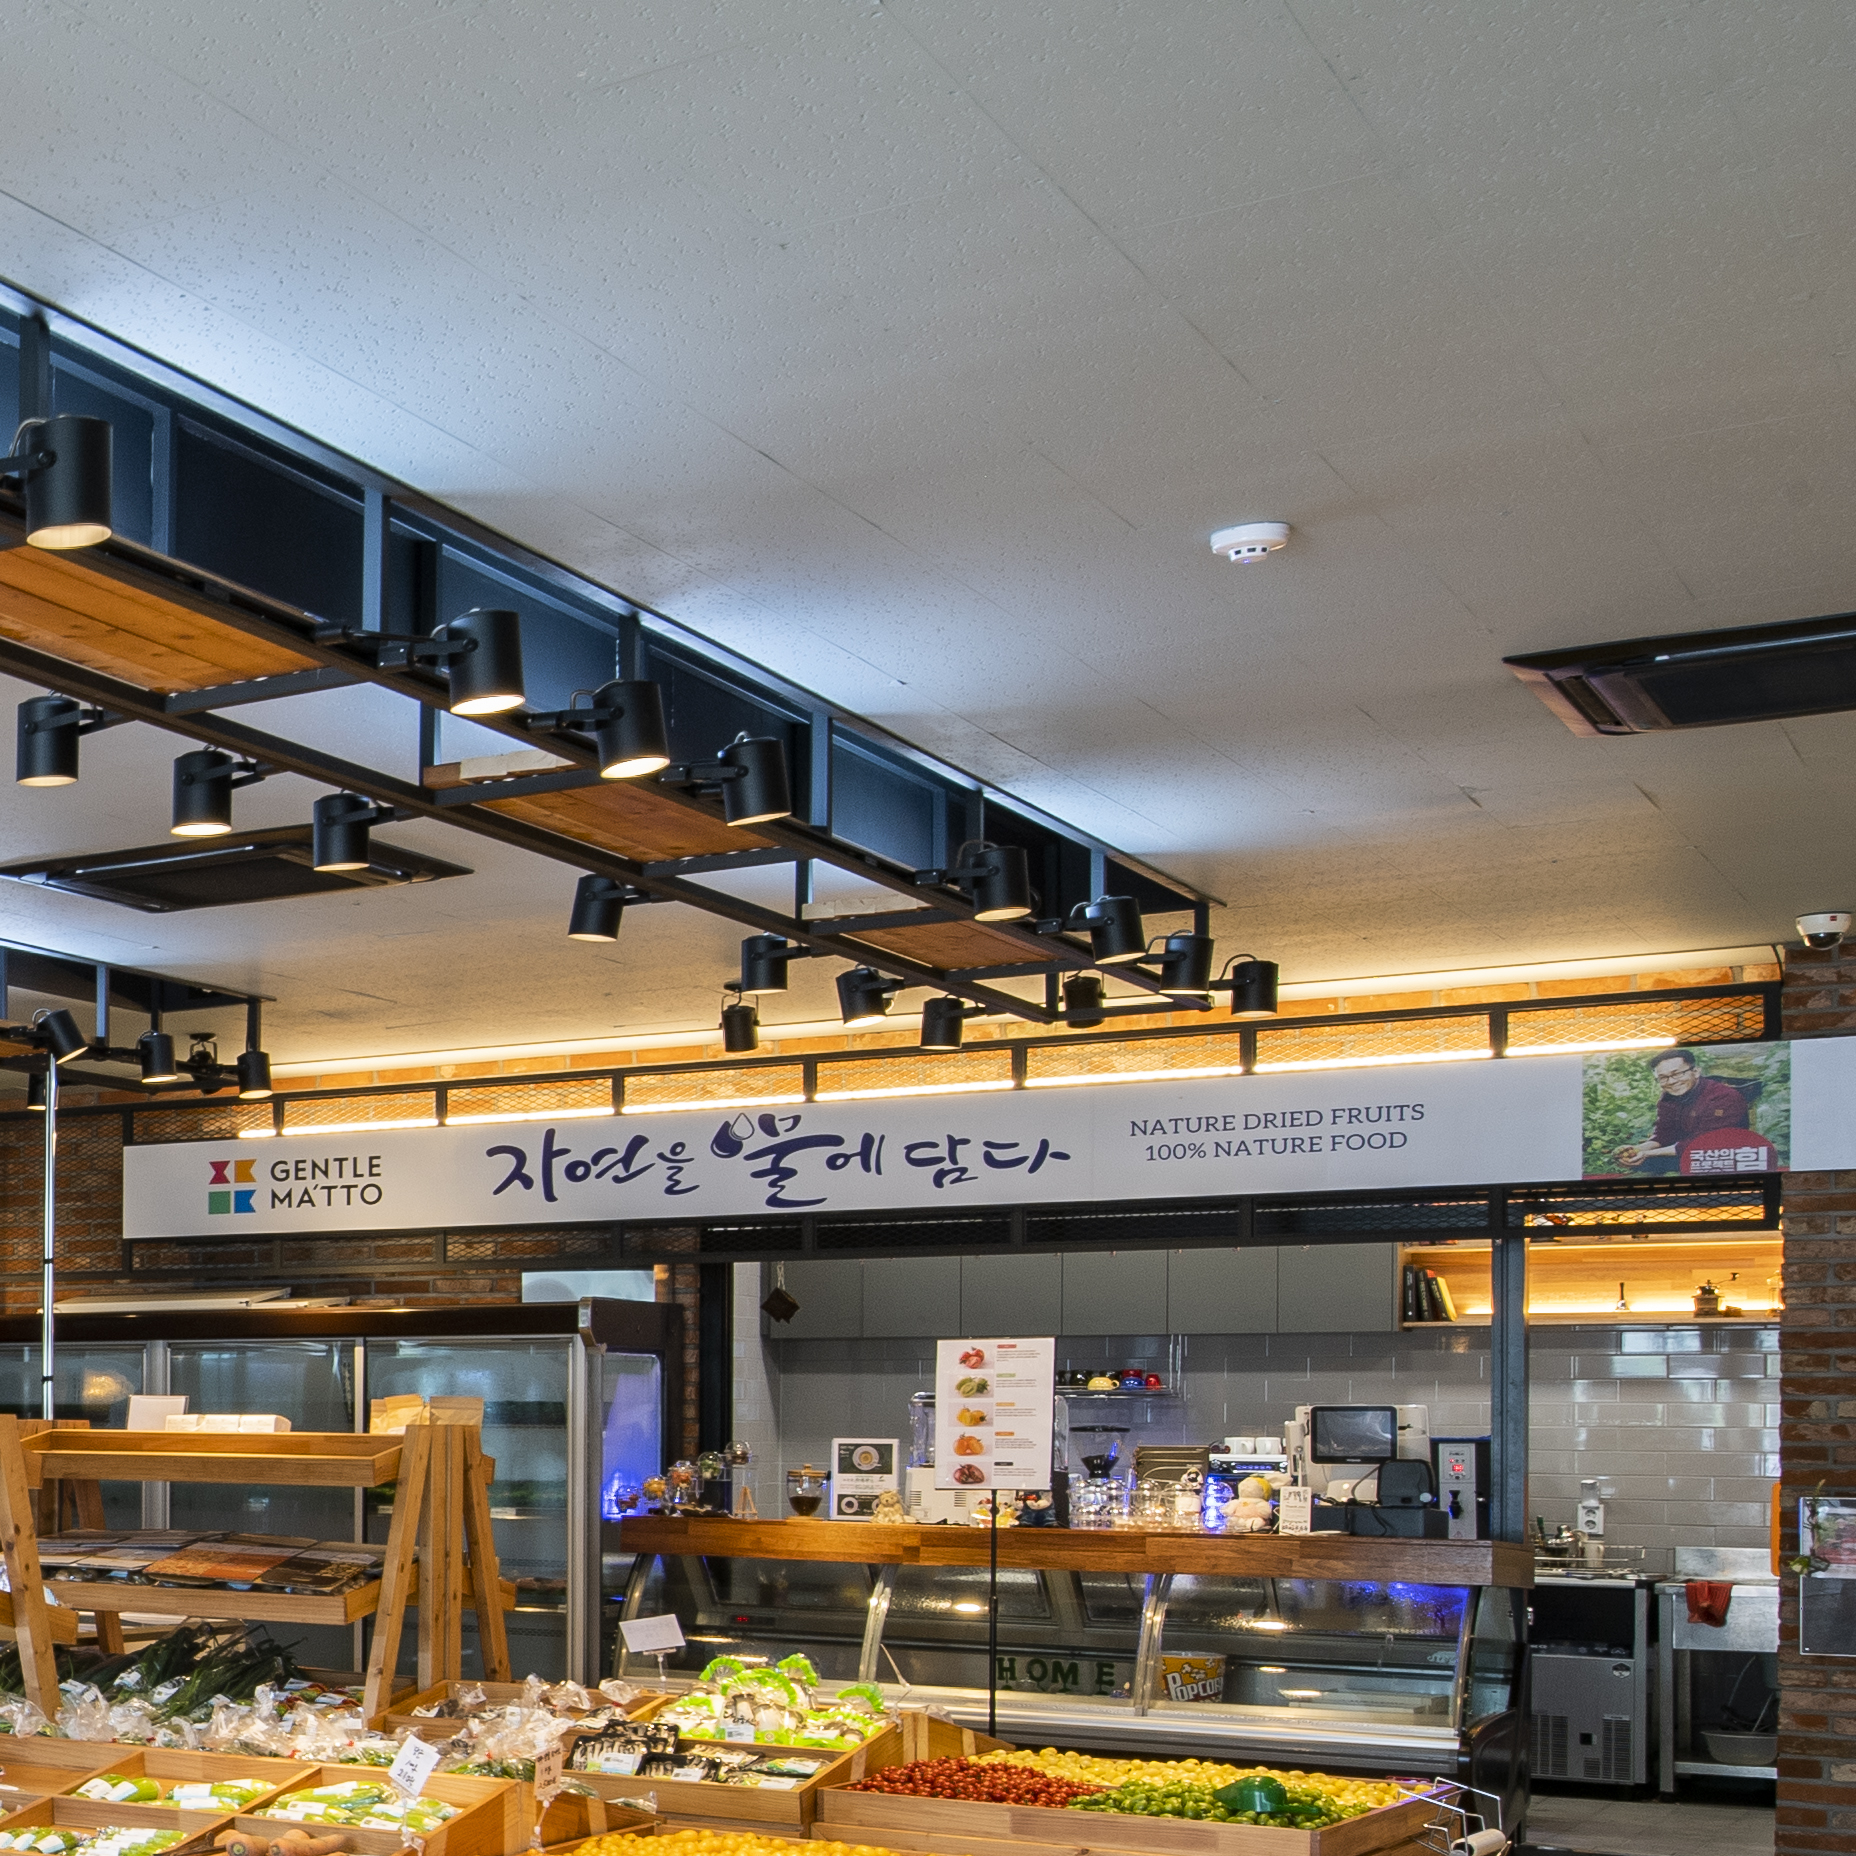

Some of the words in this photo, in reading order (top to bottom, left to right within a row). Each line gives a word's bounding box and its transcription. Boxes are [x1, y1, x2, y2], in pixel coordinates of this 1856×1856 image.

[1130, 1110, 1237, 1137] NATURE
[1243, 1107, 1323, 1133] DRIED
[1330, 1103, 1426, 1129] FRUITS
[1145, 1140, 1207, 1162] 100%
[1213, 1135, 1321, 1160] NATURE
[1329, 1130, 1409, 1153] FOOD
[269, 1154, 382, 1179] GENTLE
[996, 1656, 1115, 1687] HOME
